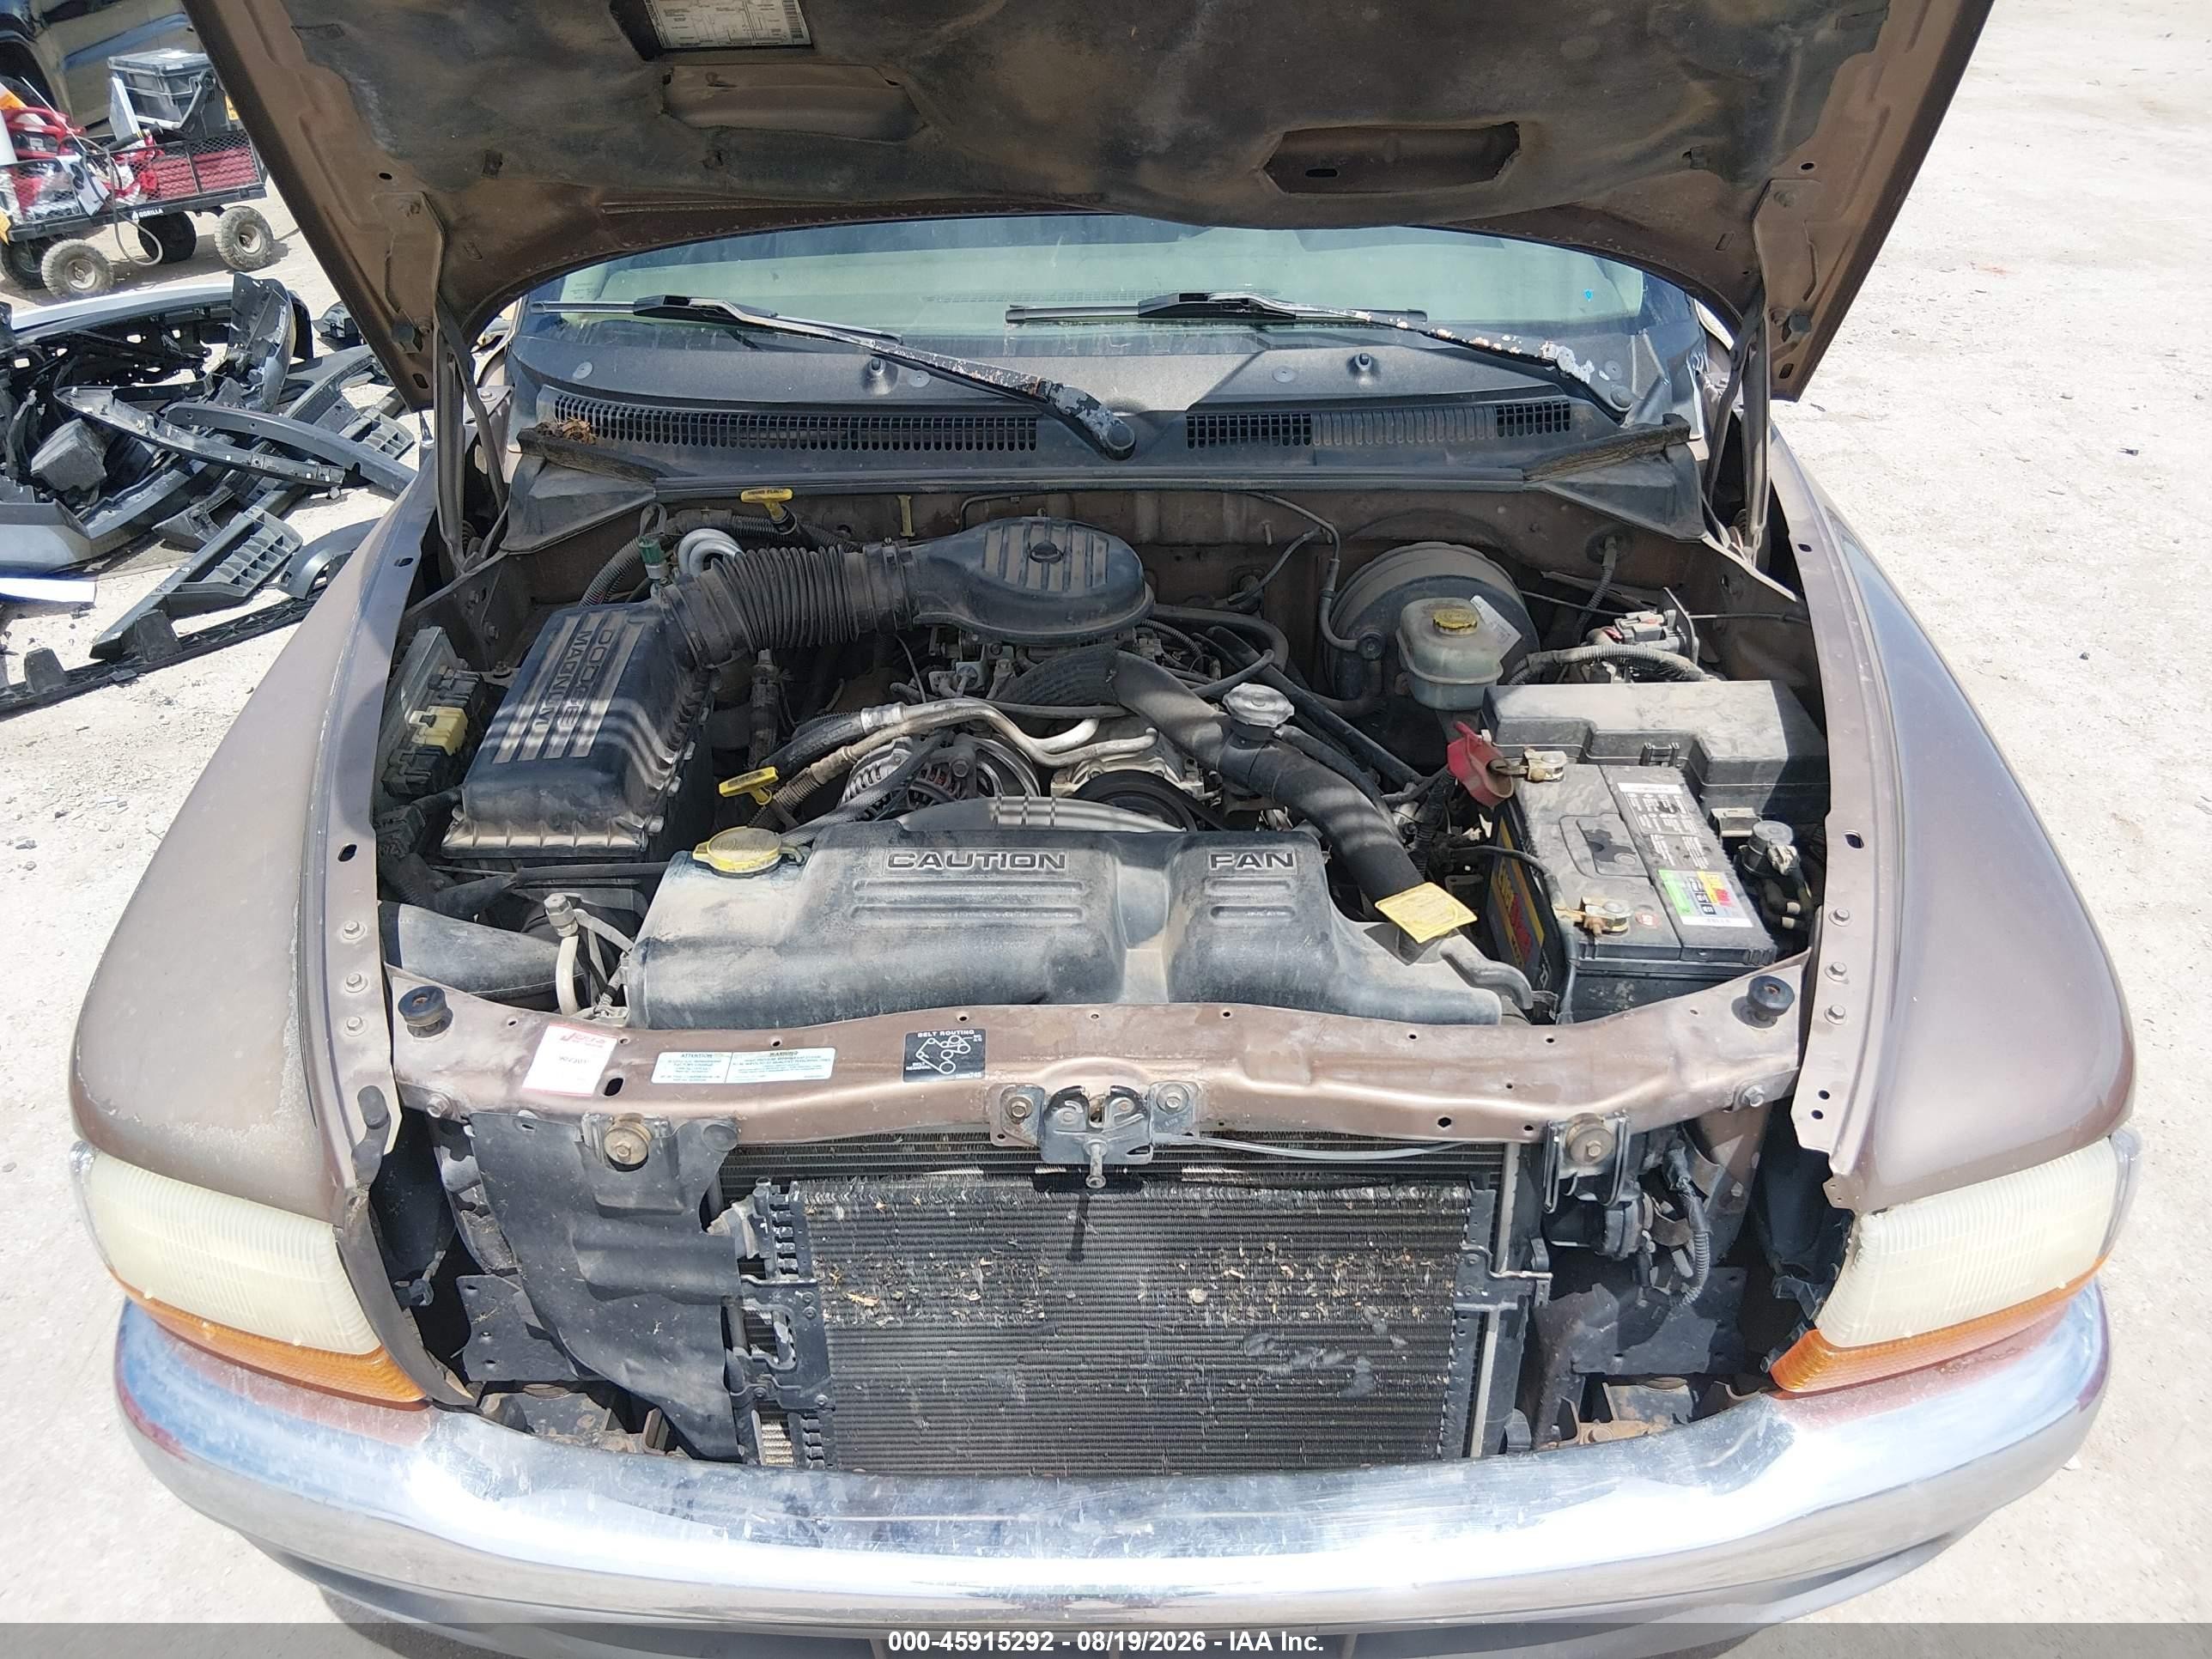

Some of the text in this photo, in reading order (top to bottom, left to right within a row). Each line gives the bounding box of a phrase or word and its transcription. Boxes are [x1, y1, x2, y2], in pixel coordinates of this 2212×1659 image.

[138, 208, 163, 217] GORILLA
[536, 629, 592, 726] MAGNUM
[557, 629, 612, 728] DODGE
[887, 851, 1295, 870] CAUTION FAN
